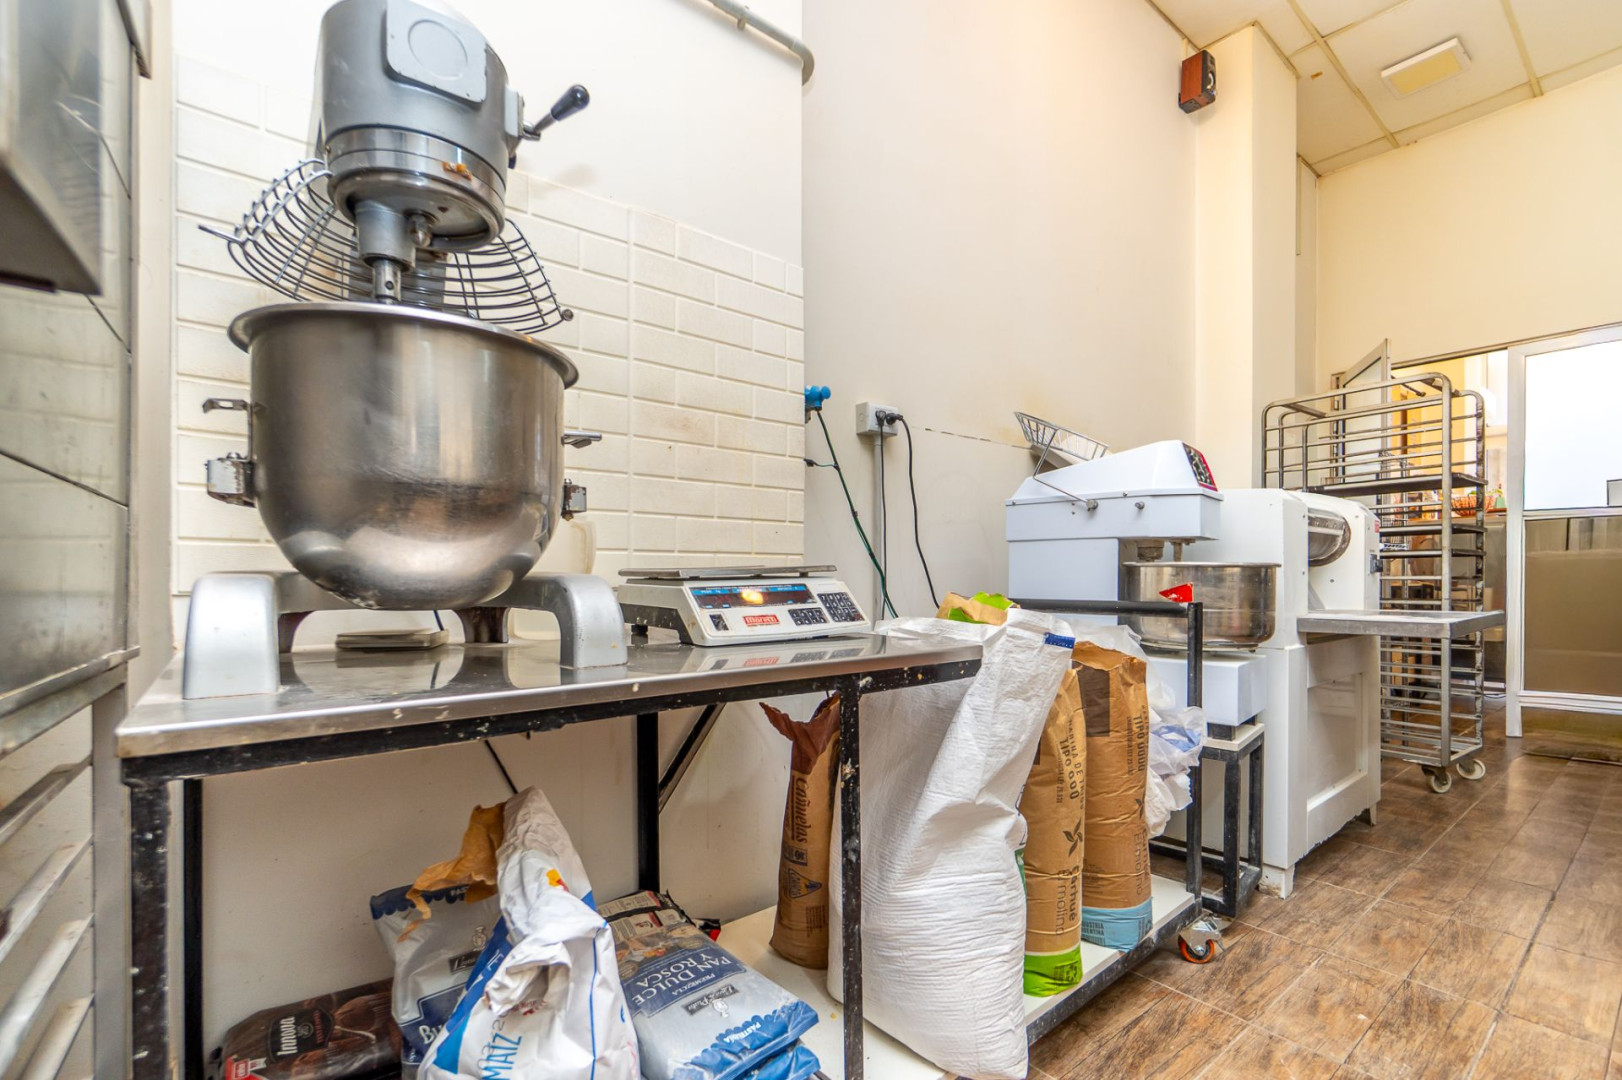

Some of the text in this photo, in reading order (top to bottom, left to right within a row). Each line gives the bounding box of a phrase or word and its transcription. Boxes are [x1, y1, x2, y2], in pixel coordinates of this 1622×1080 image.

[1133, 715, 1146, 740] TIPO
[1067, 720, 1078, 759] HARINA
[1074, 762, 1084, 776] DE
[1059, 737, 1080, 800] TIPO 000
[795, 777, 812, 843] Cañuelas
[1055, 885, 1068, 936] molino
[636, 958, 700, 989] ROSCA
[696, 955, 732, 975] PAN
[699, 952, 714, 965] Y
[631, 967, 694, 1006] DULCE
[671, 972, 717, 996] PREMEZCLA
[276, 1016, 298, 1056] Innova
